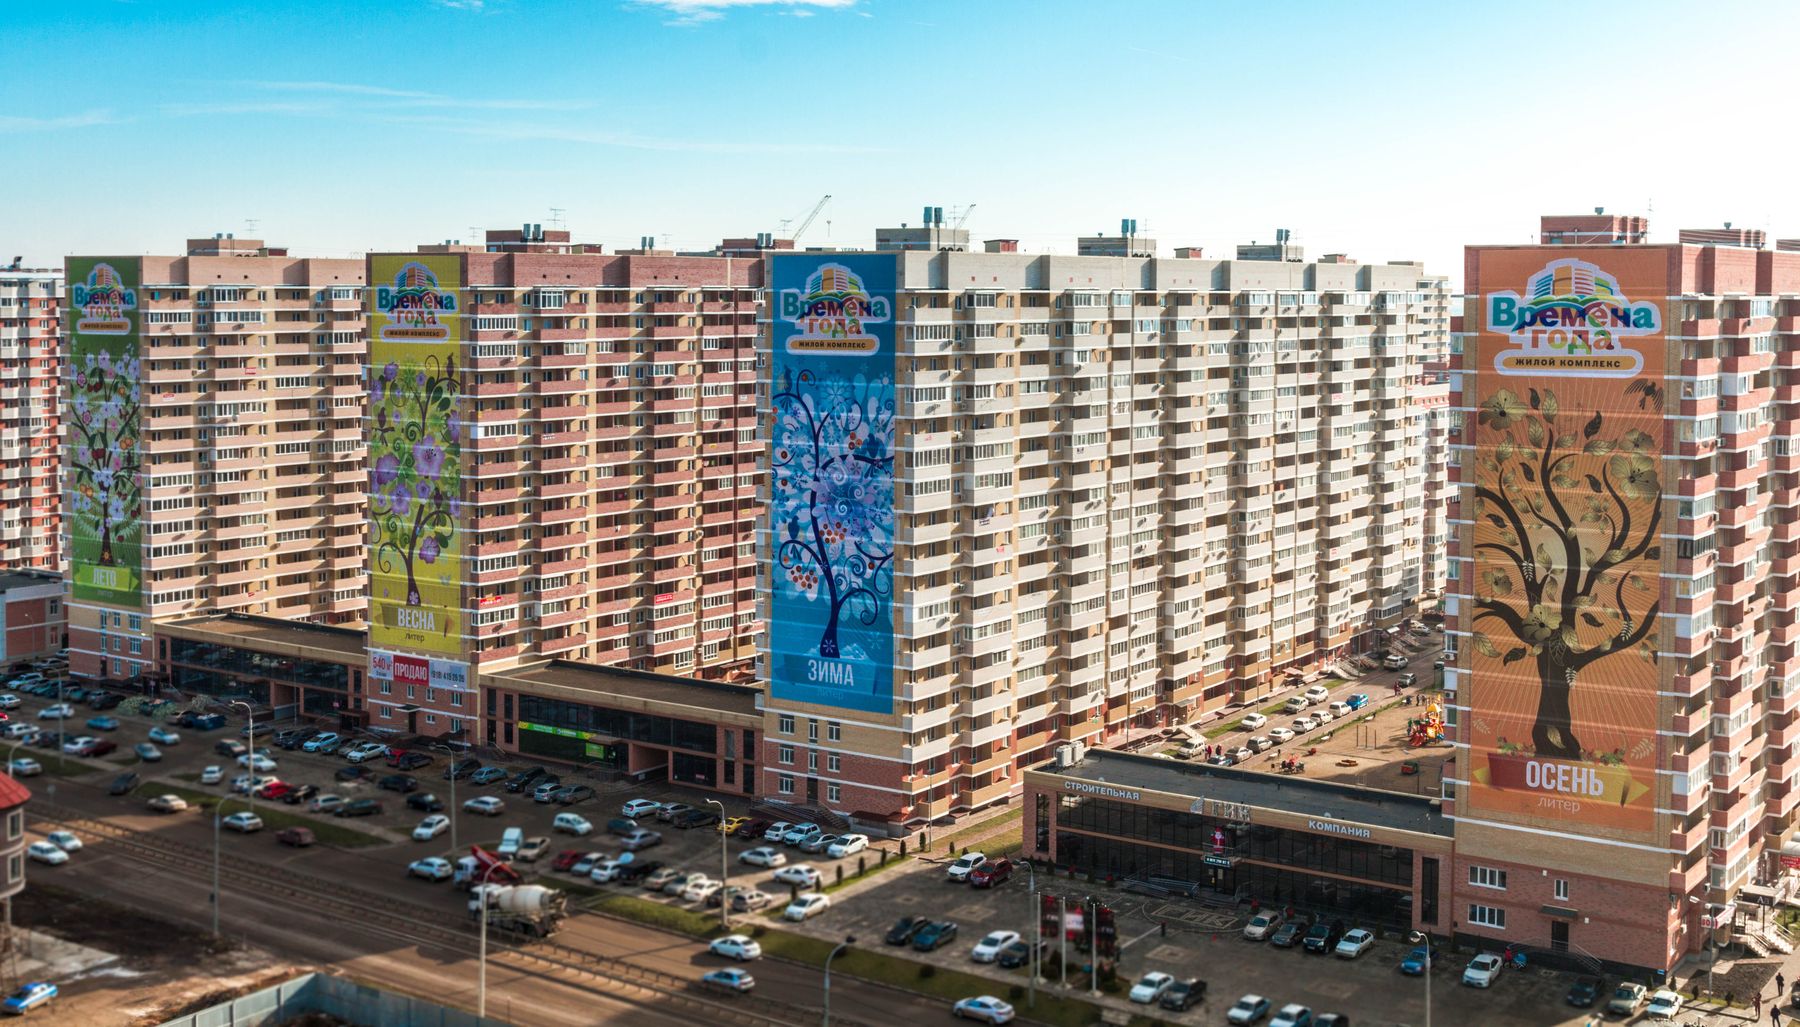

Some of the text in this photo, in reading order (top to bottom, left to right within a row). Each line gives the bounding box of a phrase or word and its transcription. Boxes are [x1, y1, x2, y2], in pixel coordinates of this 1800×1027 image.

[783, 292, 888, 320] Времена
[1492, 297, 1655, 332] Времена
[799, 340, 866, 349] ЖИЛОЙ КОМПЛЕКС
[1515, 357, 1621, 368] ЖИЛОЙ КОМПЛЕКС
[93, 567, 117, 588] ЛЕТО
[397, 607, 435, 632] ВЕСНА
[394, 662, 428, 681] ПРОДАЮ
[808, 659, 854, 687] ЗИМА
[1525, 760, 1604, 797] ОСЕНЬ
[1064, 781, 1140, 801] СТРОИТЕЛЬНАЯ
[1308, 820, 1371, 839] КОМПАНИЯ
[1537, 797, 1581, 814] литер
